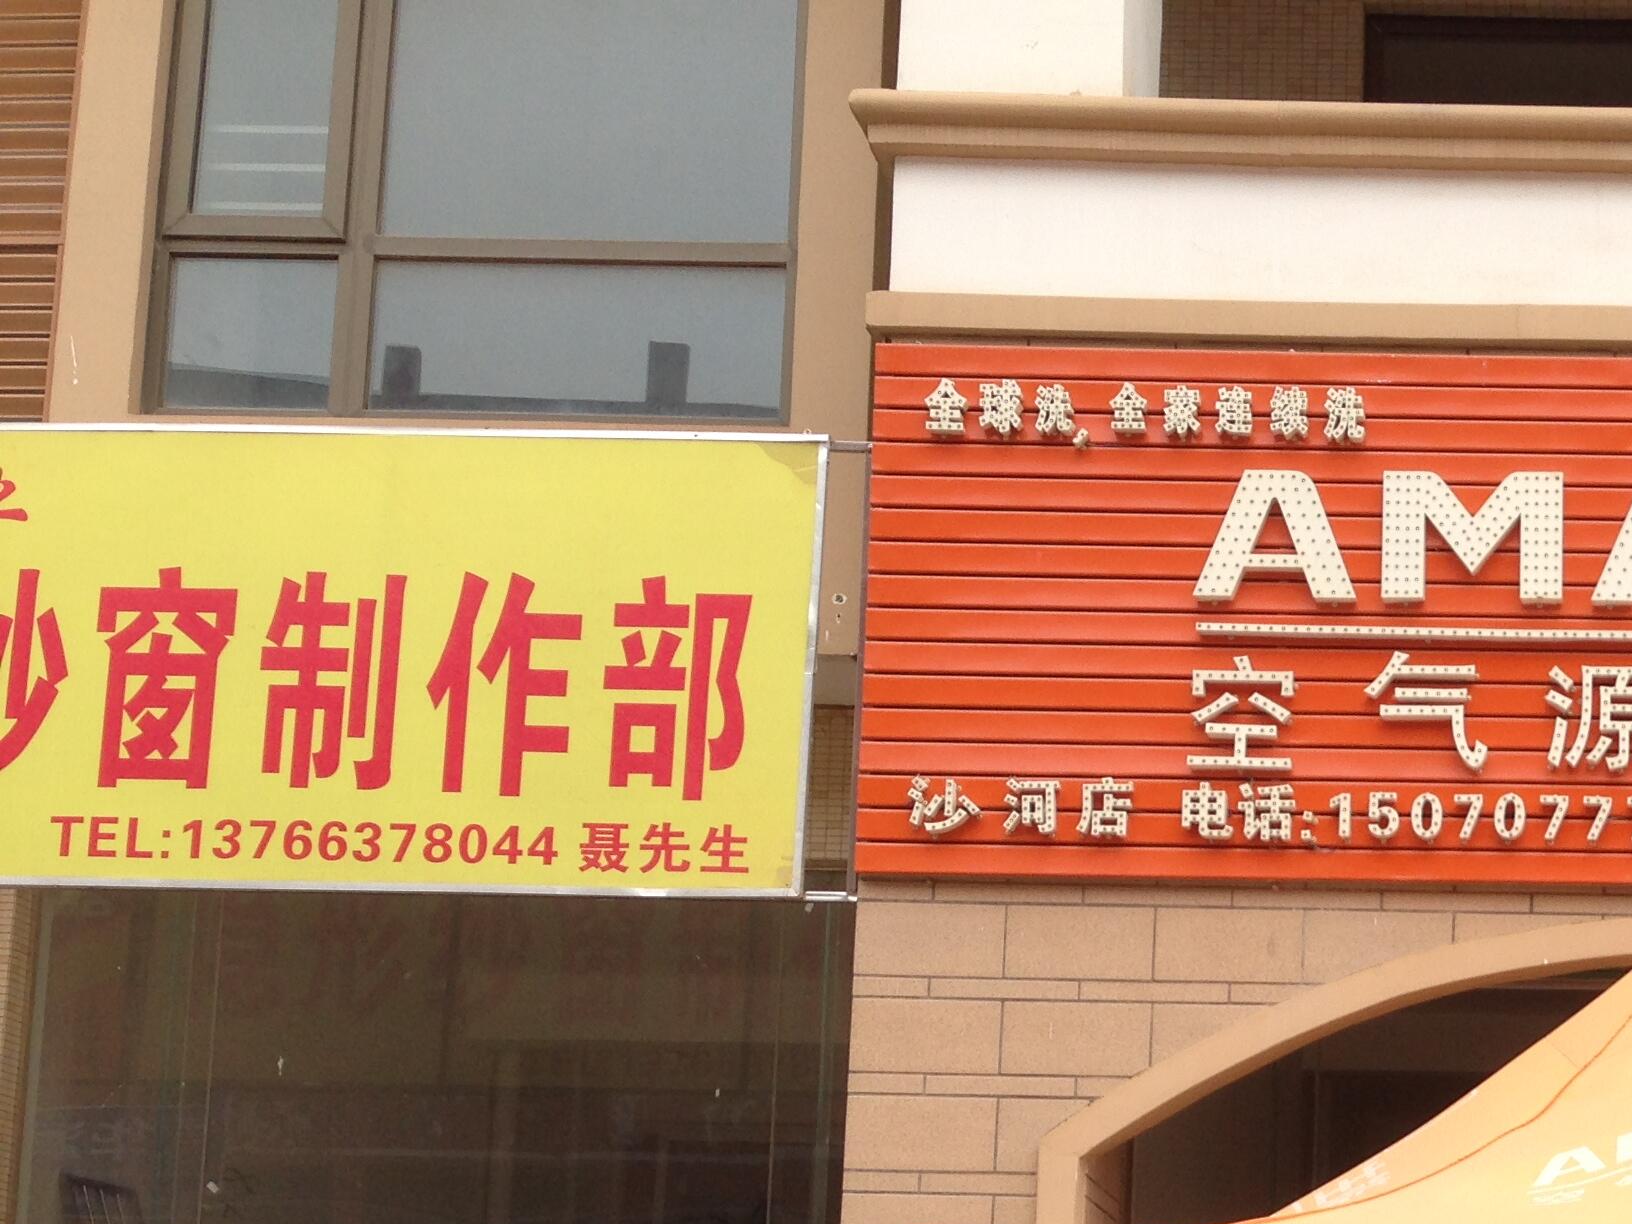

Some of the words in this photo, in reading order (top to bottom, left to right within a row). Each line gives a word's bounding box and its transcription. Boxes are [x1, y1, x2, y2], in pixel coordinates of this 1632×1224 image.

[906, 775, 1134, 837] 沙河店
[50, 815, 560, 866] TEL:13766378044
[578, 822, 750, 875] 聂先生
